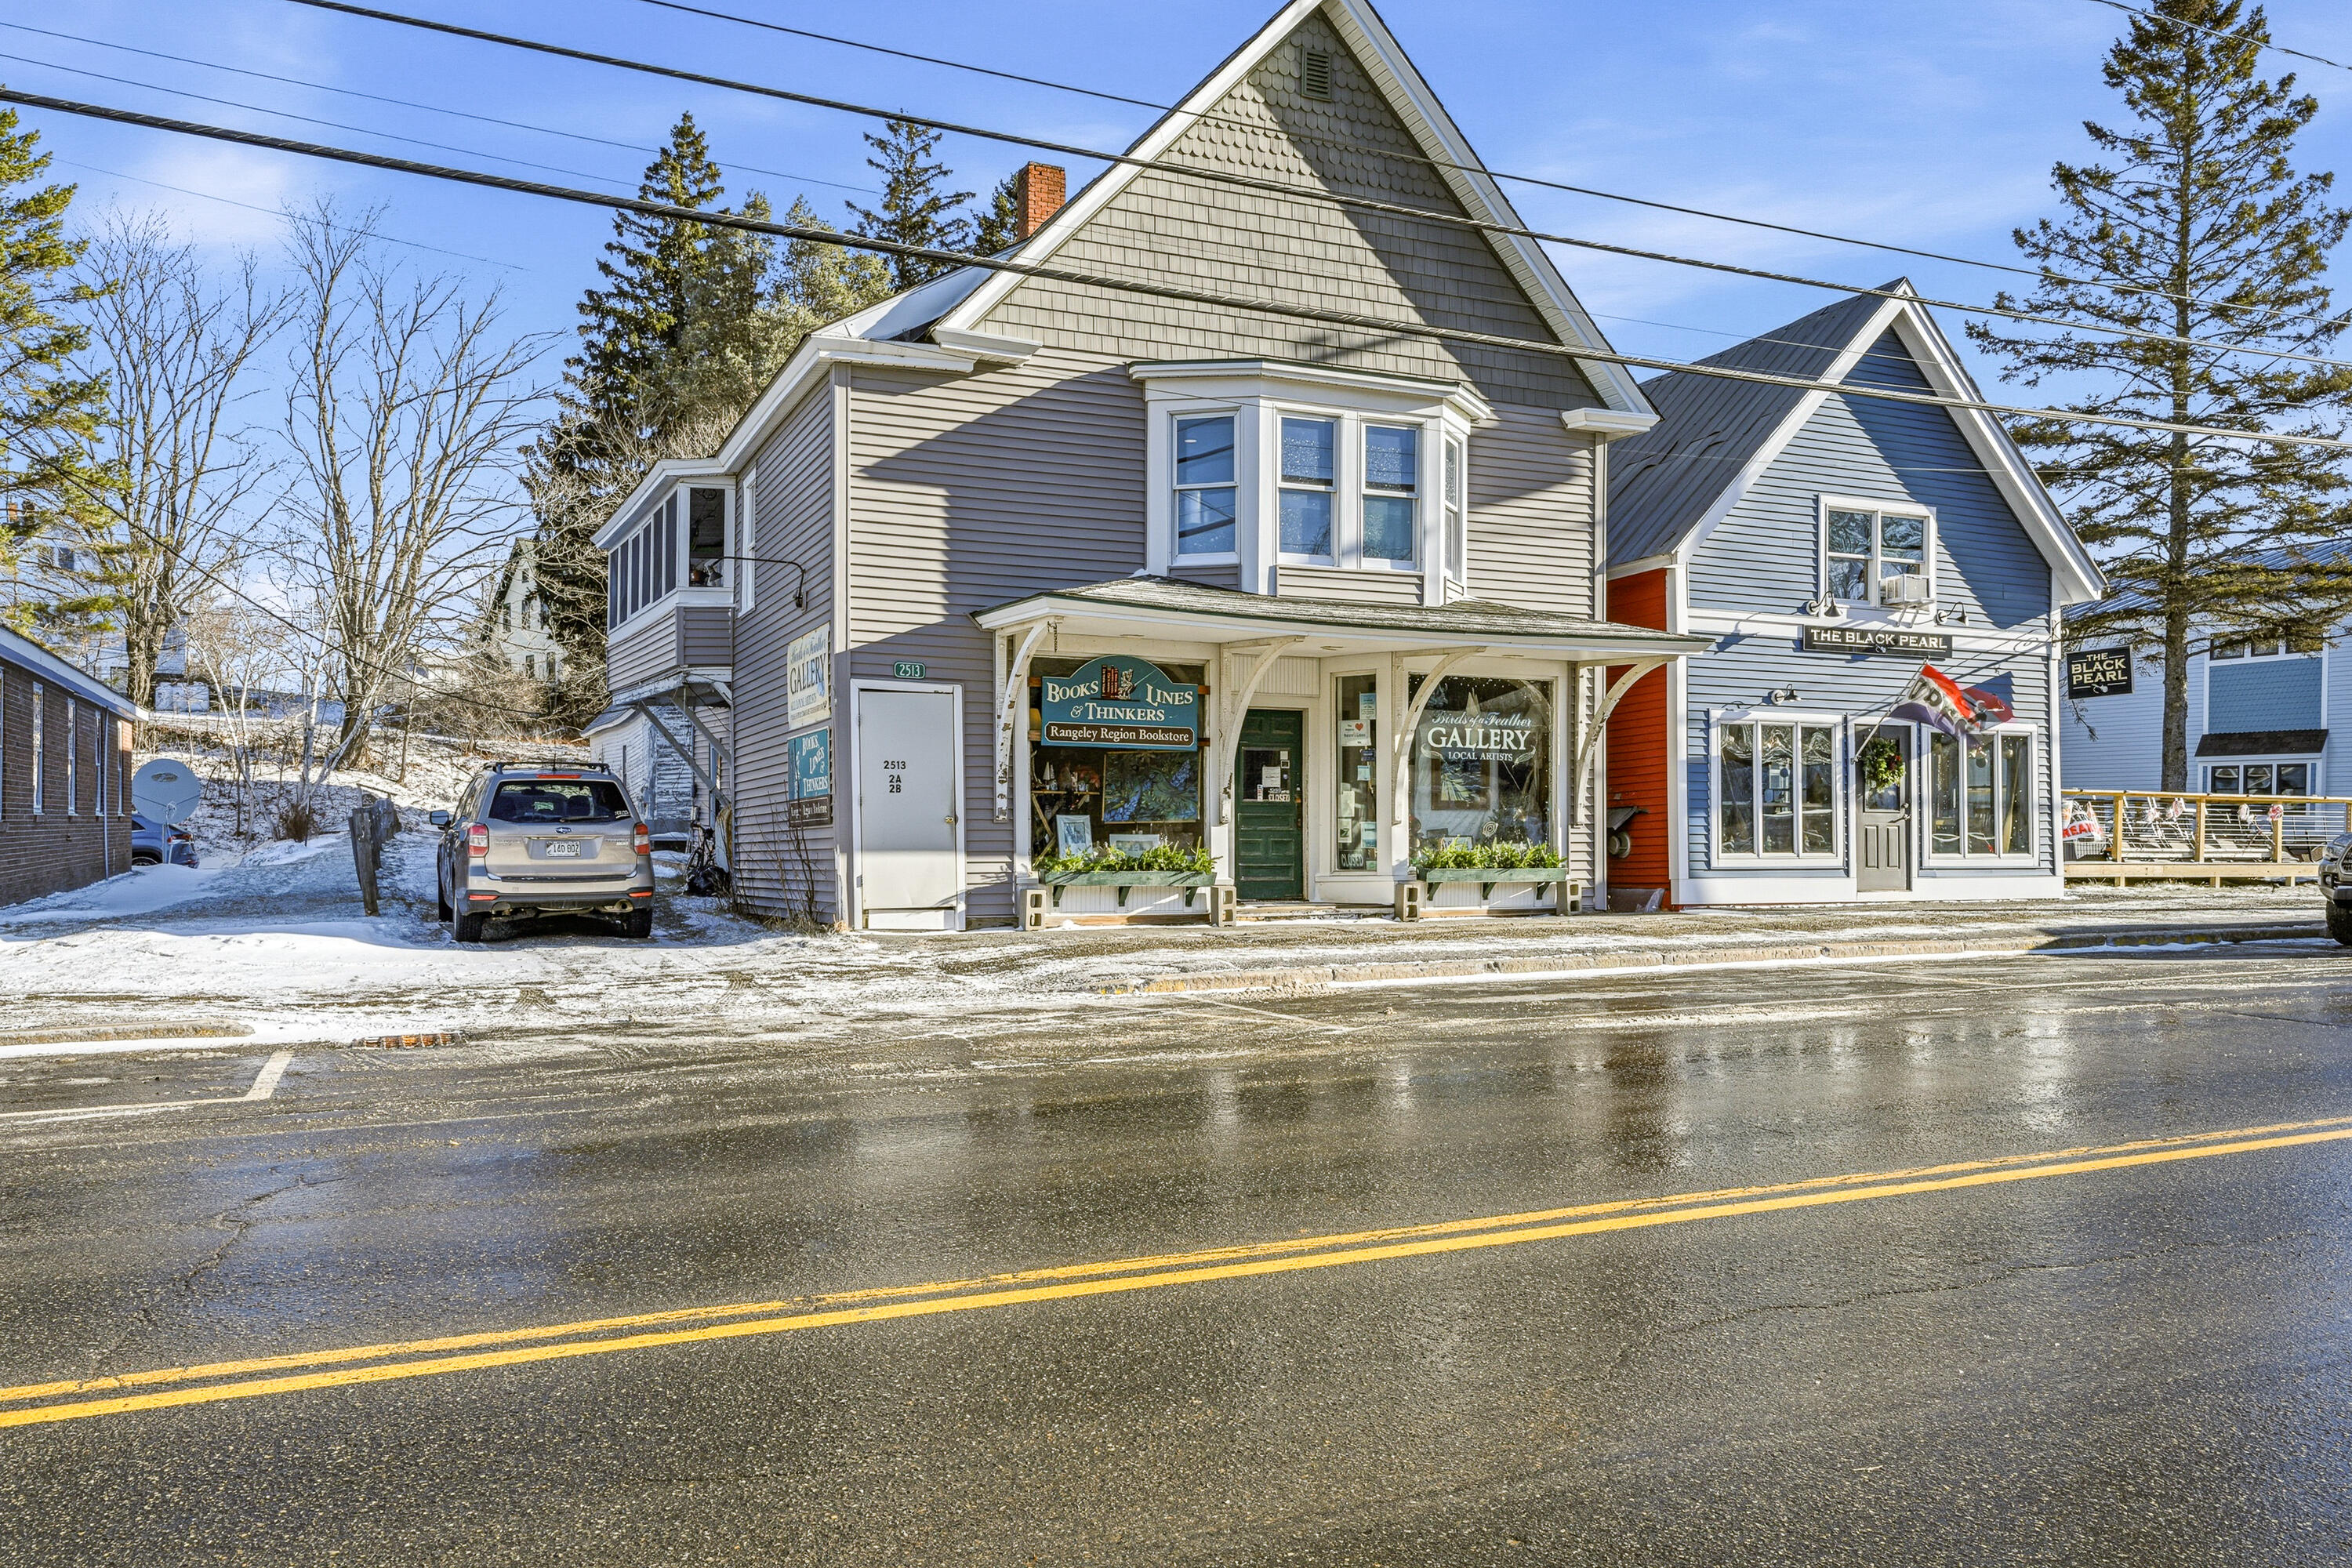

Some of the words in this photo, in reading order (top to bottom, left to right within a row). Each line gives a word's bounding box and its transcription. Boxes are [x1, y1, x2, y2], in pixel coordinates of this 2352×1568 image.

[1810, 629, 1842, 643] THE
[1846, 632, 1896, 646] BLACK
[1899, 635, 1948, 649] PEARL
[2086, 652, 2108, 662] THE
[789, 653, 826, 695] GALLERY
[899, 664, 920, 677] 2513
[2071, 658, 2126, 674] BLACK
[2072, 670, 2128, 685] PEARL
[1046, 680, 1099, 703] BOOKS
[1145, 683, 1193, 707] LINES
[1070, 705, 1083, 718] &
[1085, 702, 1165, 722] THINKERS
[1432, 710, 1468, 724] Birds
[1484, 711, 1531, 728] Feather
[1050, 725, 1098, 742] Rangeley
[1100, 728, 1136, 742] Region
[1139, 728, 1189, 742] Bookstore
[1427, 727, 1531, 751] GALLERY
[1448, 751, 1477, 760] LOCAL
[1480, 751, 1513, 761] ARTISTS
[884, 760, 906, 770] 2513
[803, 775, 828, 797] THINKERS
[889, 775, 902, 783] 2A
[889, 784, 902, 793] 2B
